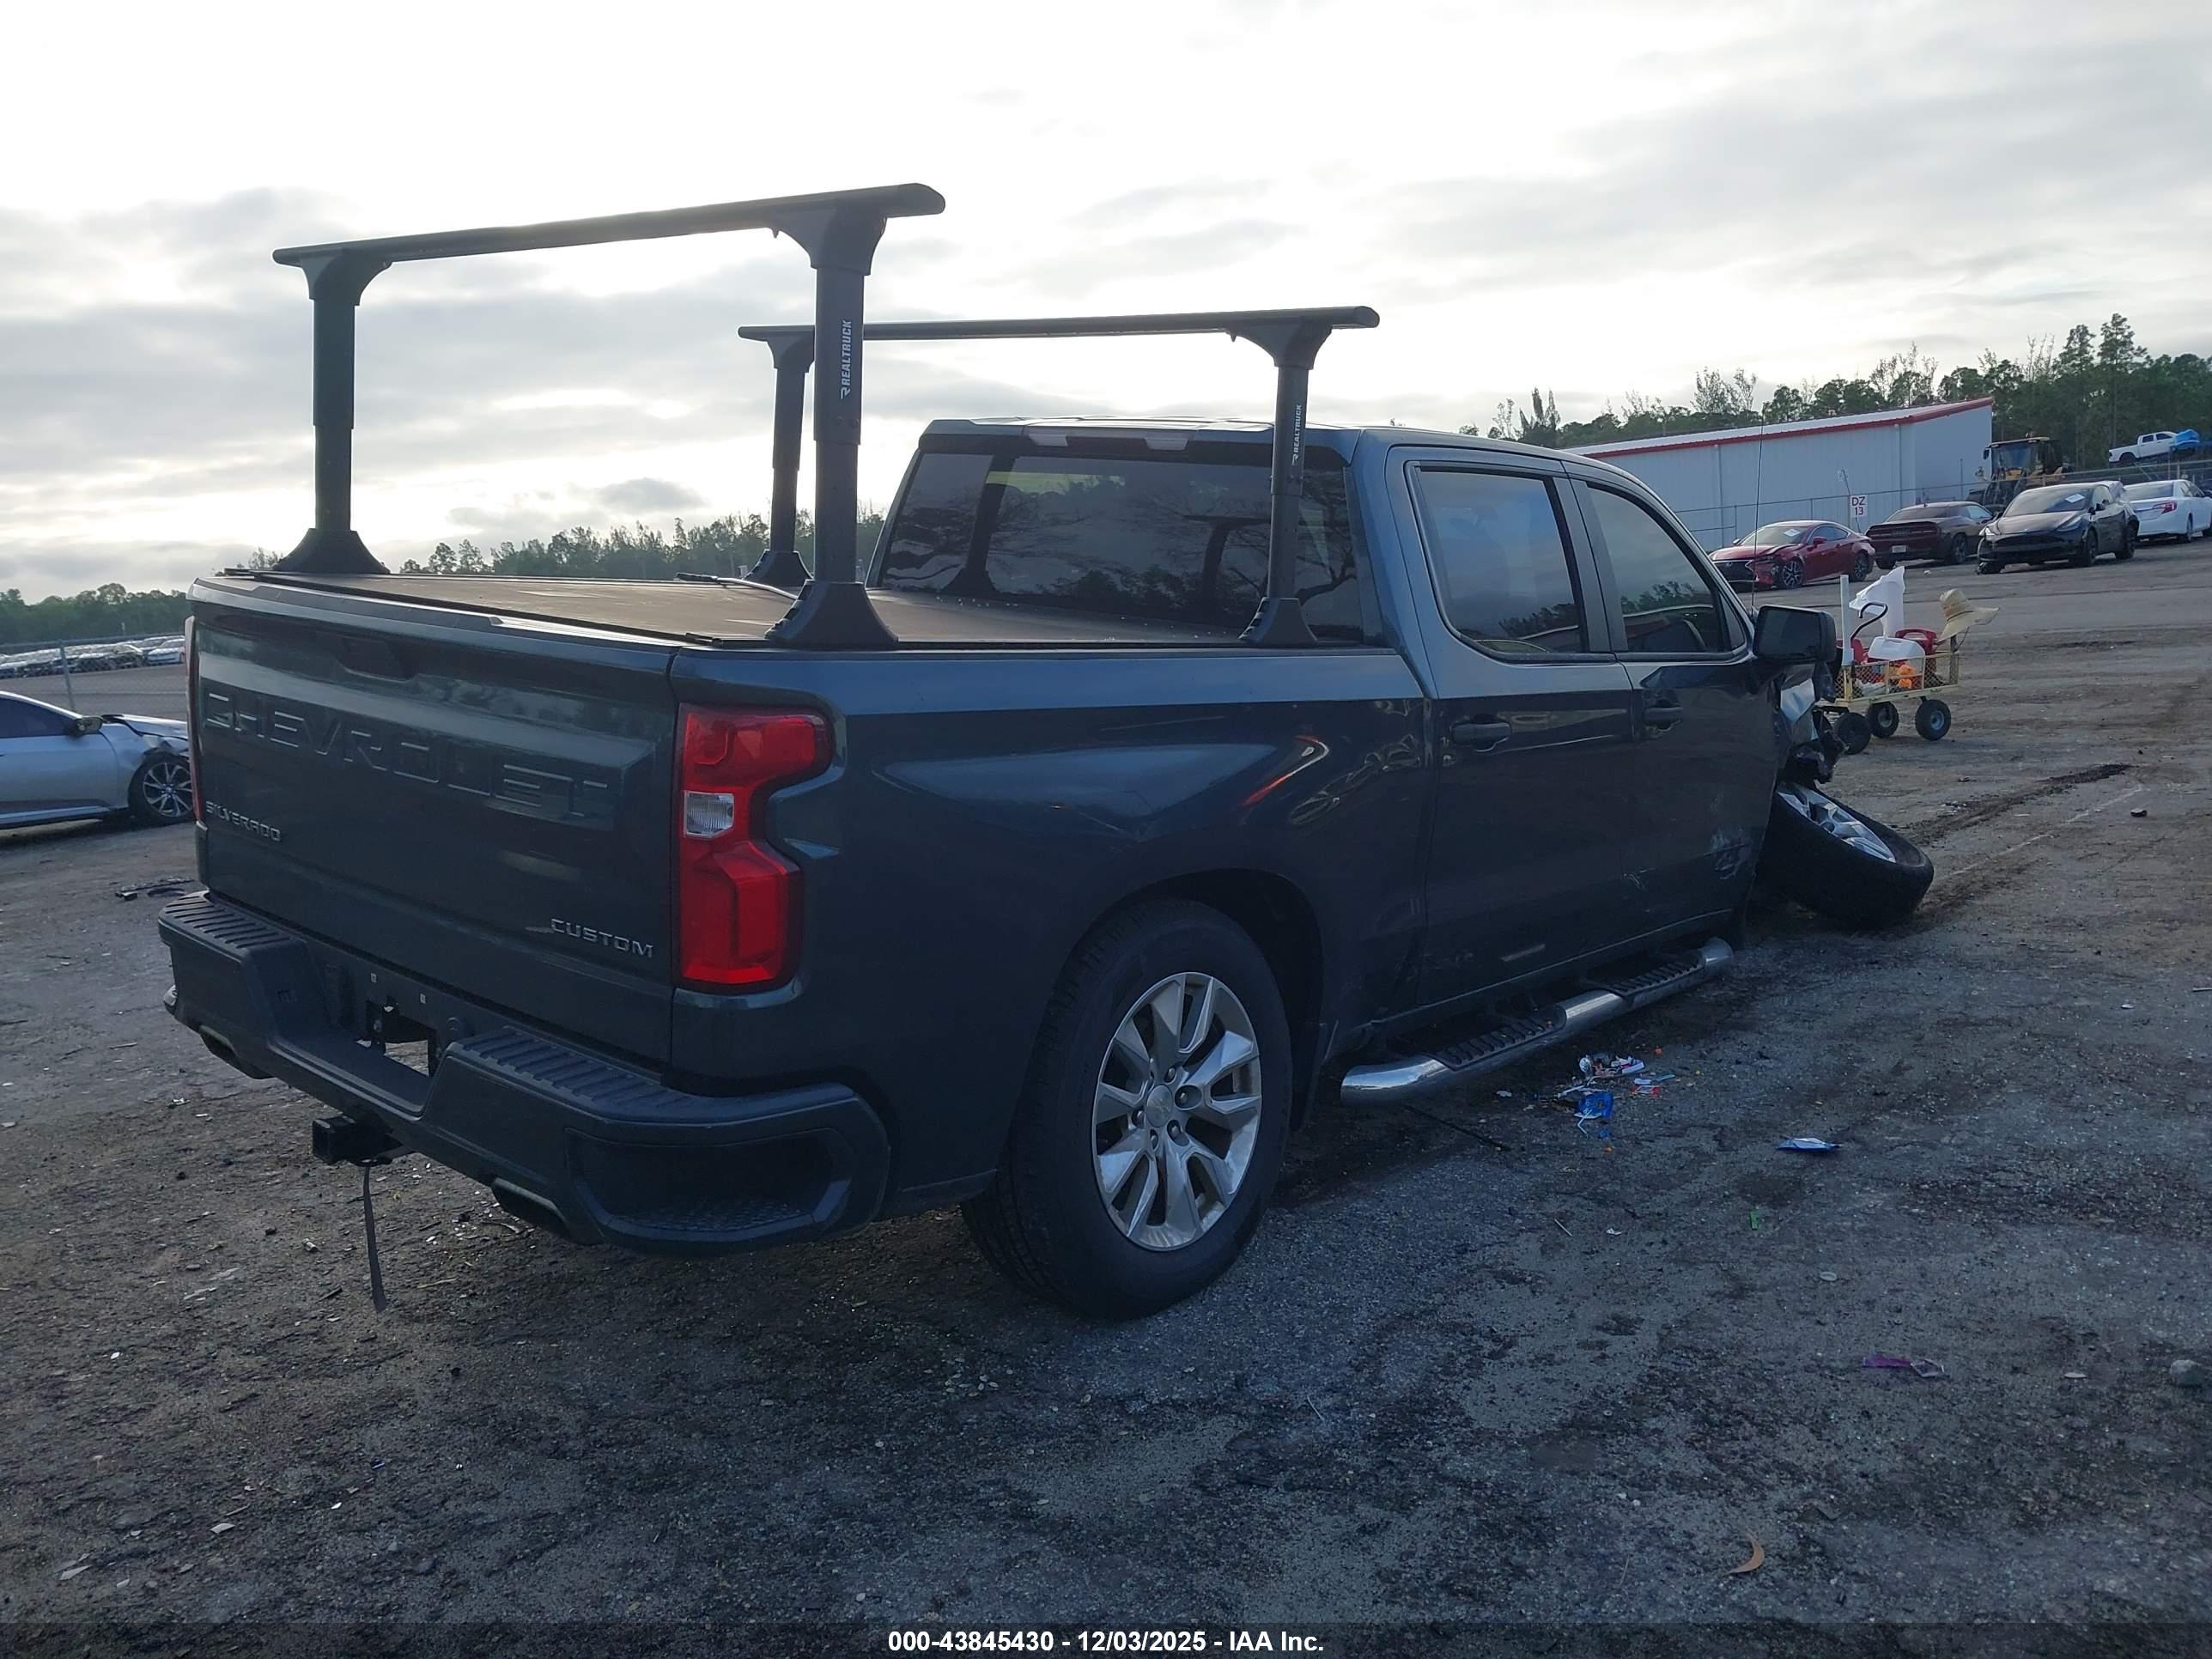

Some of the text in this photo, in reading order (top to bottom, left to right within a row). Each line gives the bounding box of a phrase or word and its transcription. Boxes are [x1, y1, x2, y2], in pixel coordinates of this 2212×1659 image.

[842, 319, 851, 386] REALTRUCK
[1293, 404, 1302, 453] REALTRUCK
[1851, 496, 1866, 507] DZ
[1855, 507, 1864, 516] 13
[205, 692, 608, 817] CHEVROLET
[205, 800, 282, 842] SILVERADO
[550, 919, 655, 958] CUSTOM
